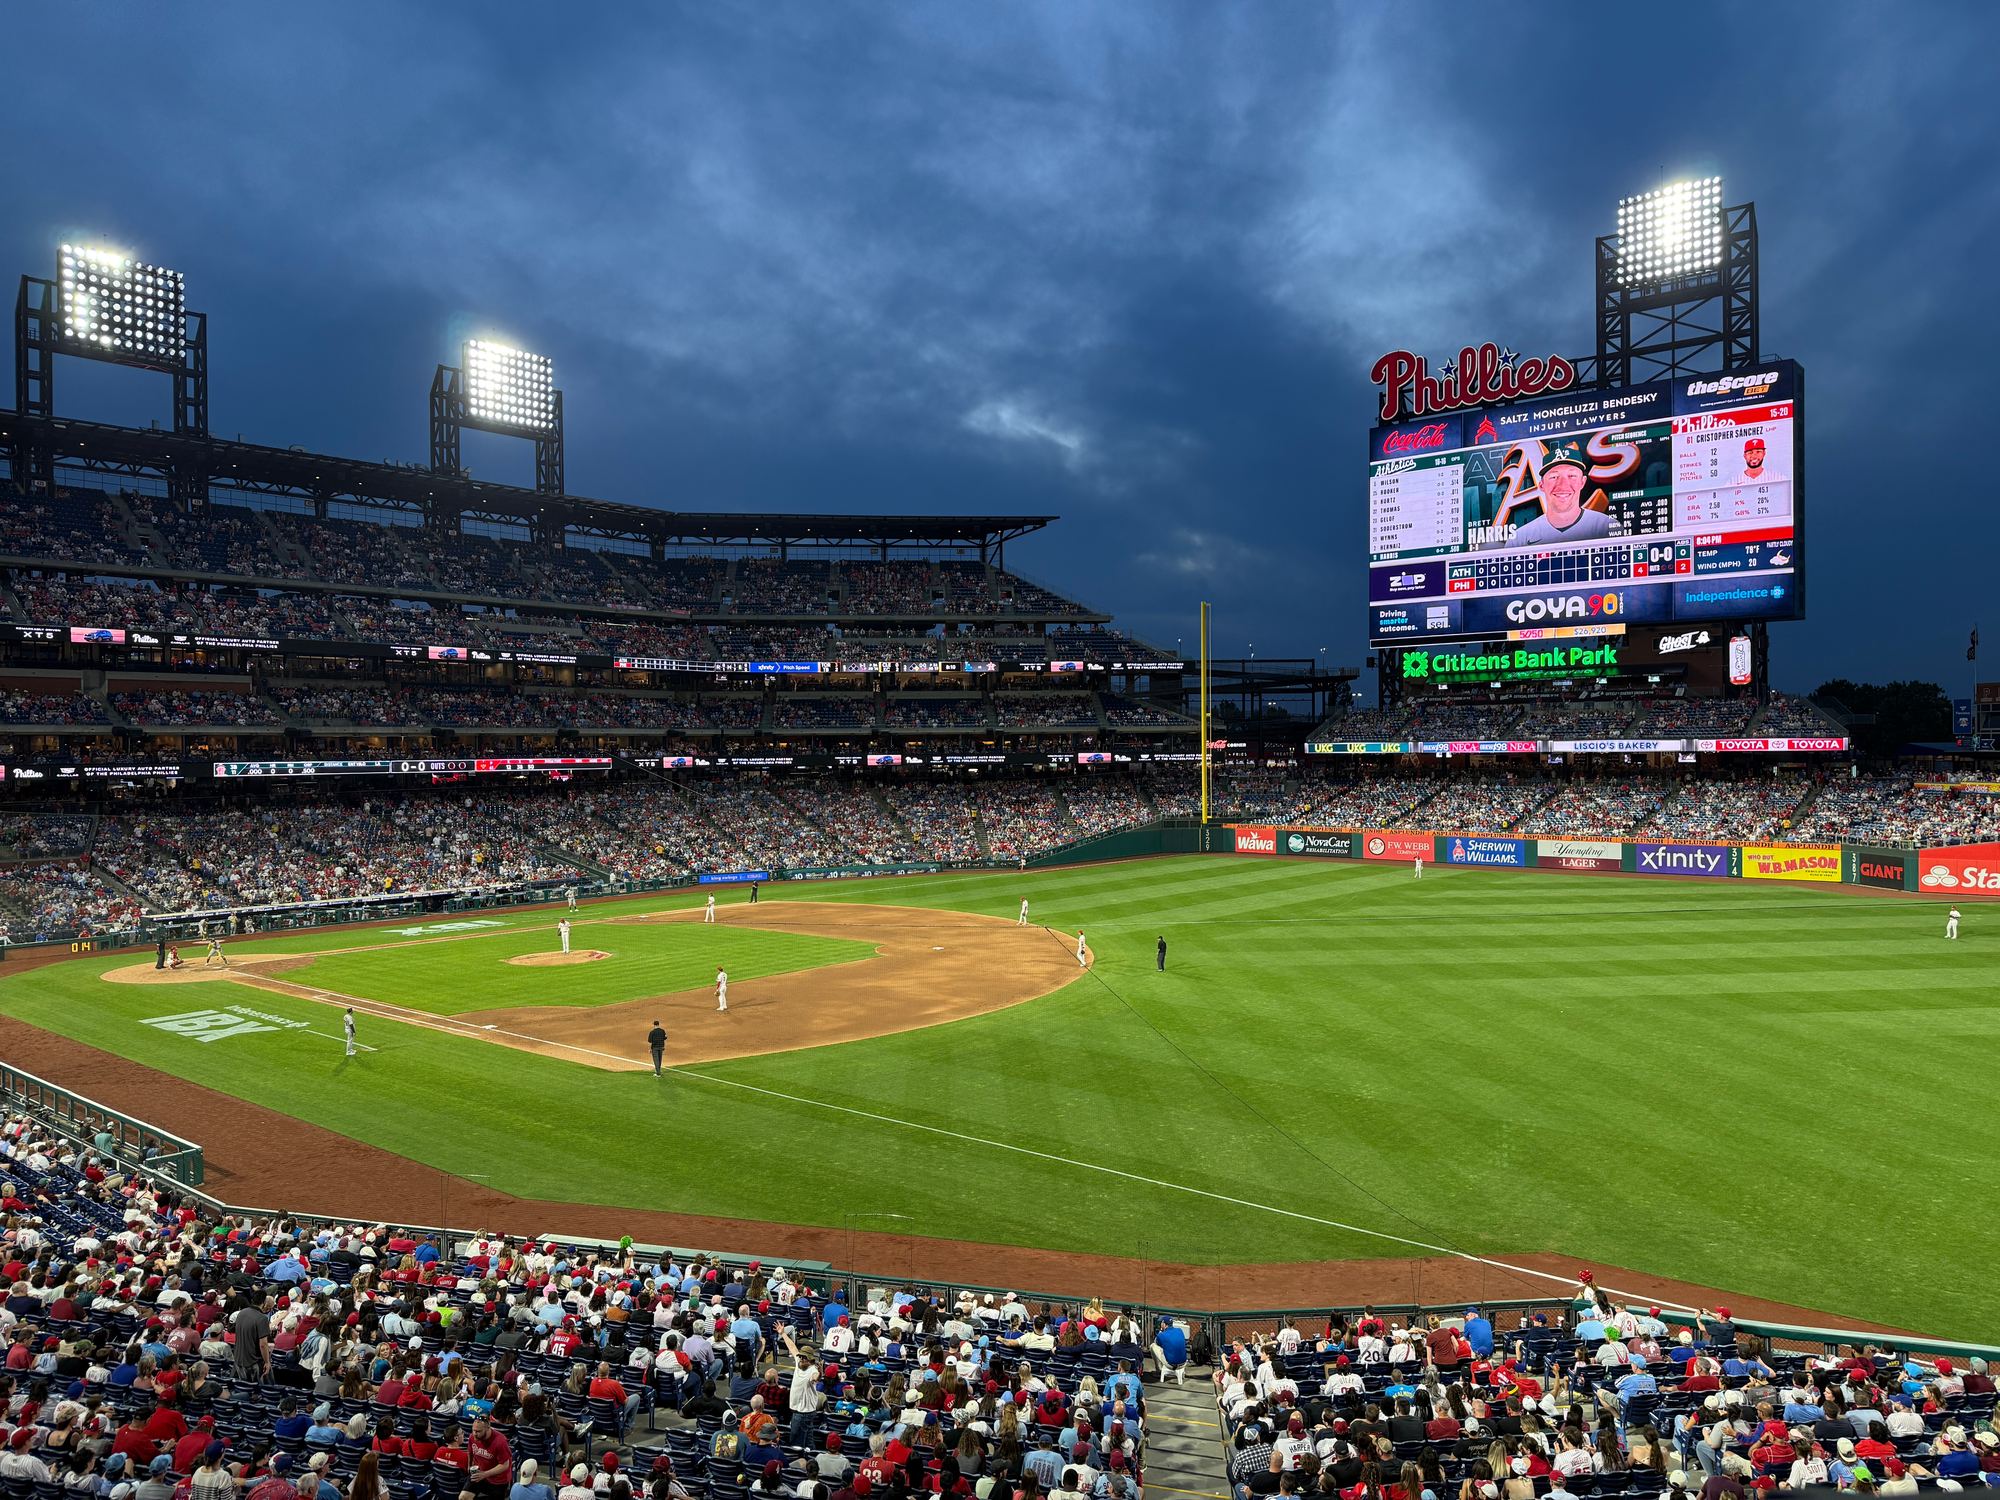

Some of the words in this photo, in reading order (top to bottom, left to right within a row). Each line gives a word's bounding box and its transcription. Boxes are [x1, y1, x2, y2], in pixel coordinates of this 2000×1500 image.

[1370, 342, 1574, 421] Phillies
[1687, 371, 1779, 396] theScore
[1500, 413, 1529, 425] SALTZ
[1533, 402, 1598, 420] MONGELUZZI
[1603, 392, 1658, 410] BENDESKY
[1529, 421, 1568, 433] INJURY
[1576, 411, 1626, 426] LAWYERS
[1673, 415, 1735, 434] Phillies
[1770, 407, 1788, 418] 15-20
[1383, 423, 1448, 454] Coca-Cola
[1687, 436, 1693, 444] 61
[1696, 430, 1733, 443] CRISTOPHER
[1711, 448, 1717, 456] 12
[1375, 458, 1416, 477] Athletics
[1468, 519, 1490, 527] BRETT
[1468, 524, 1517, 544] HARRIS
[1712, 535, 1722, 543] PM
[1651, 546, 1673, 562] 0-0
[1697, 562, 1717, 570] WIND
[1719, 561, 1741, 569] (MPH)
[1748, 558, 1757, 567] 20
[1452, 567, 1471, 577] ATH
[1454, 581, 1470, 590] PHI
[1686, 588, 1768, 603] Independence
[1588, 593, 1618, 616] 90
[1380, 610, 1407, 618] Driving
[1574, 626, 1606, 636] $26,920
[132, 633, 159, 644] Phillies
[1659, 631, 1700, 654] GHOST
[1432, 651, 1510, 672] Citizens
[1515, 647, 1565, 669] Bank
[1570, 644, 1617, 666] Park
[1314, 743, 1333, 752] UKG
[1347, 743, 1365, 752] UKG
[1381, 743, 1400, 752] UKG
[1452, 743, 1477, 752] NECA
[1510, 743, 1536, 752] NECA
[1574, 741, 1615, 750] LISCIO'S
[1618, 741, 1658, 750] BAKERY
[1720, 740, 1764, 749] TOYOTA
[1793, 739, 1839, 749] TOYOTA
[431, 762, 445, 770] OUTS
[13, 768, 43, 779] Phillies
[1237, 834, 1274, 851] Wawa
[1305, 835, 1350, 848] NovaCare
[1407, 841, 1430, 851] WEBB
[1467, 839, 1515, 852] SHERWIN
[1305, 847, 1348, 855] REHABILITATION
[1553, 842, 1606, 857] Yuengling
[1467, 850, 1518, 864] WILLIAMS.
[1641, 846, 1721, 872] xfinity
[1562, 859, 1596, 868] LAGER
[1860, 863, 1903, 880] GIANT
[71, 942, 78, 953] 0
[138, 1010, 282, 1043] IBX
[1627, 1320, 1632, 1331] 3
[831, 1335, 840, 1347] 3
[1287, 1342, 1296, 1351] 12
[551, 1343, 567, 1356] 45
[1364, 1351, 1379, 1362] 20
[1289, 1444, 1310, 1452] HARPER
[868, 1460, 878, 1468] LEE
[1807, 1464, 1823, 1475] STOTT
